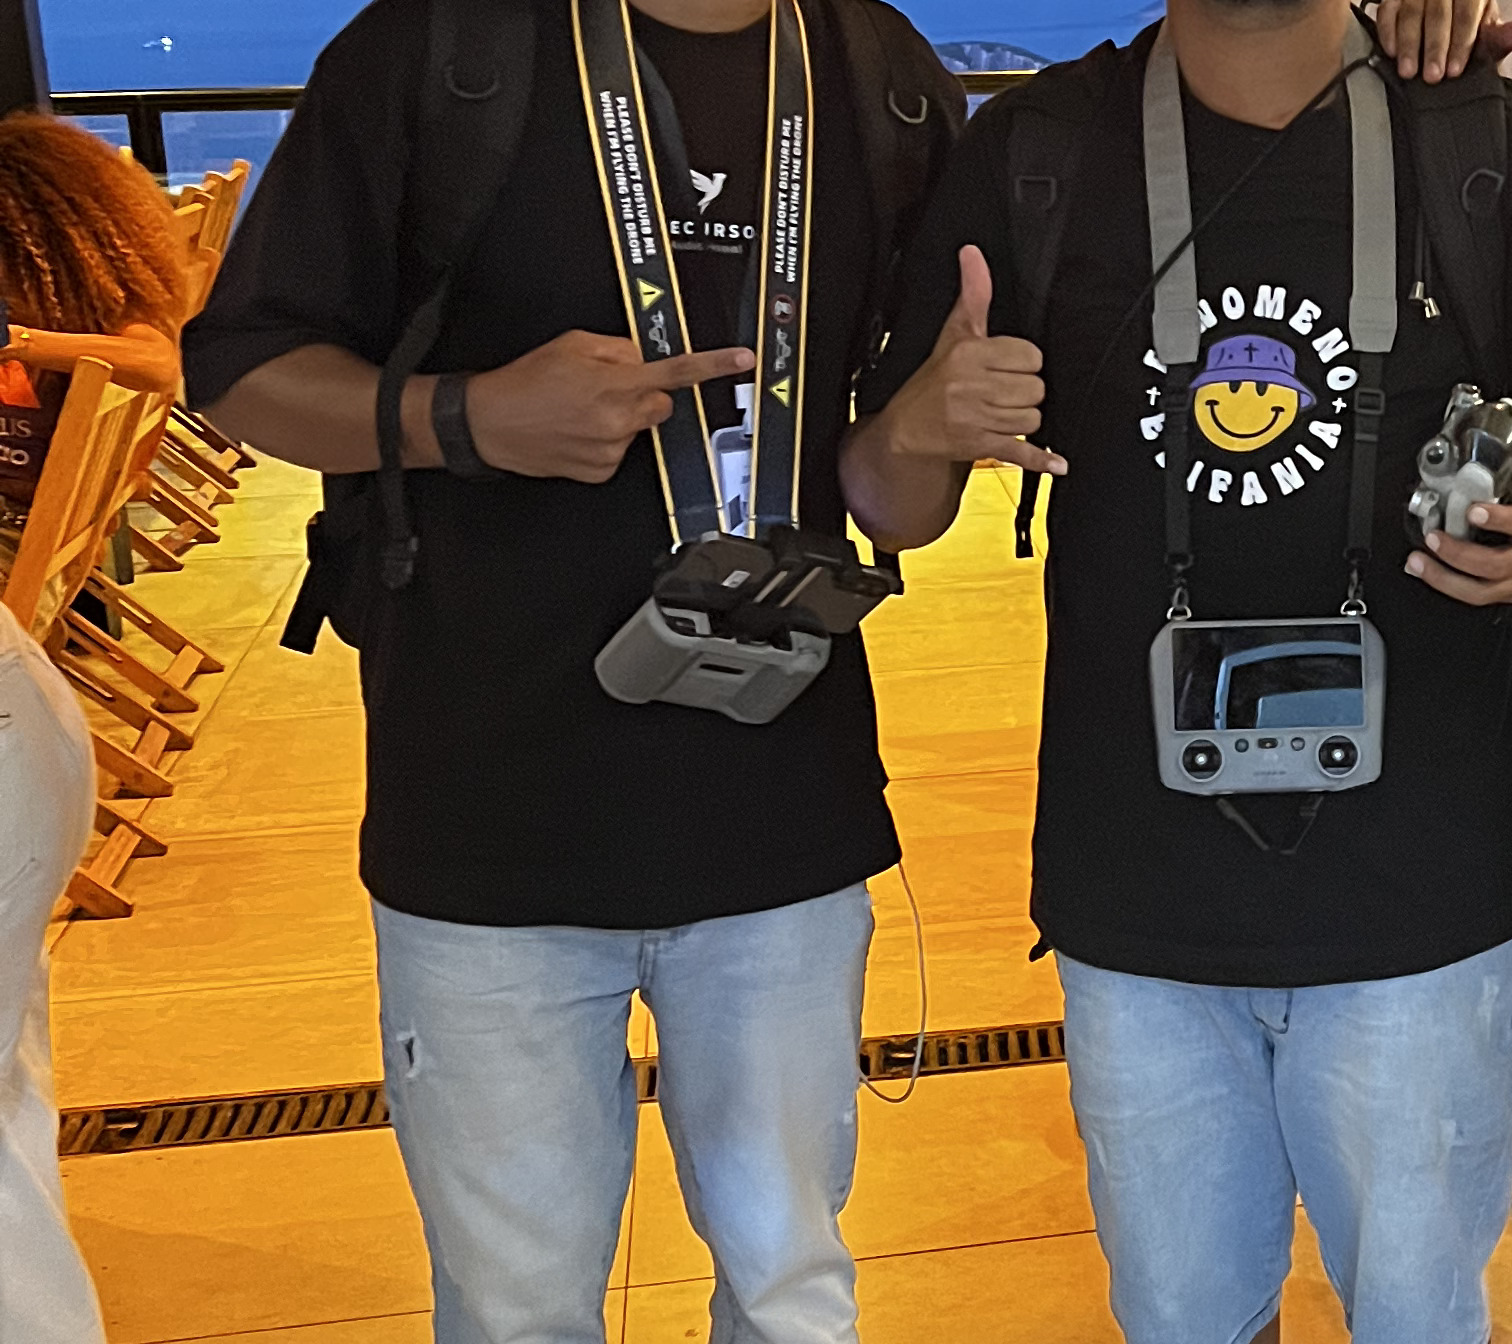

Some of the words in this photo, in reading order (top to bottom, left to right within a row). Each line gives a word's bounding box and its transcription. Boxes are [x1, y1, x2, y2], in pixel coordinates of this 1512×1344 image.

[599, 90, 616, 129] WHEN
[792, 115, 803, 156] DRONE
[610, 151, 629, 195] FLYING
[615, 96, 634, 142] PLEASE
[632, 183, 652, 234] DISTURB
[642, 237, 657, 256] ME
[778, 139, 790, 190] DISTURB
[791, 158, 802, 180] THE
[620, 197, 635, 220] THE
[788, 182, 801, 224] FLYING
[625, 222, 644, 265] DRONE
[670, 220, 756, 240] ECRSO
[774, 229, 786, 273] PLEASE
[786, 246, 798, 283] WHEN
